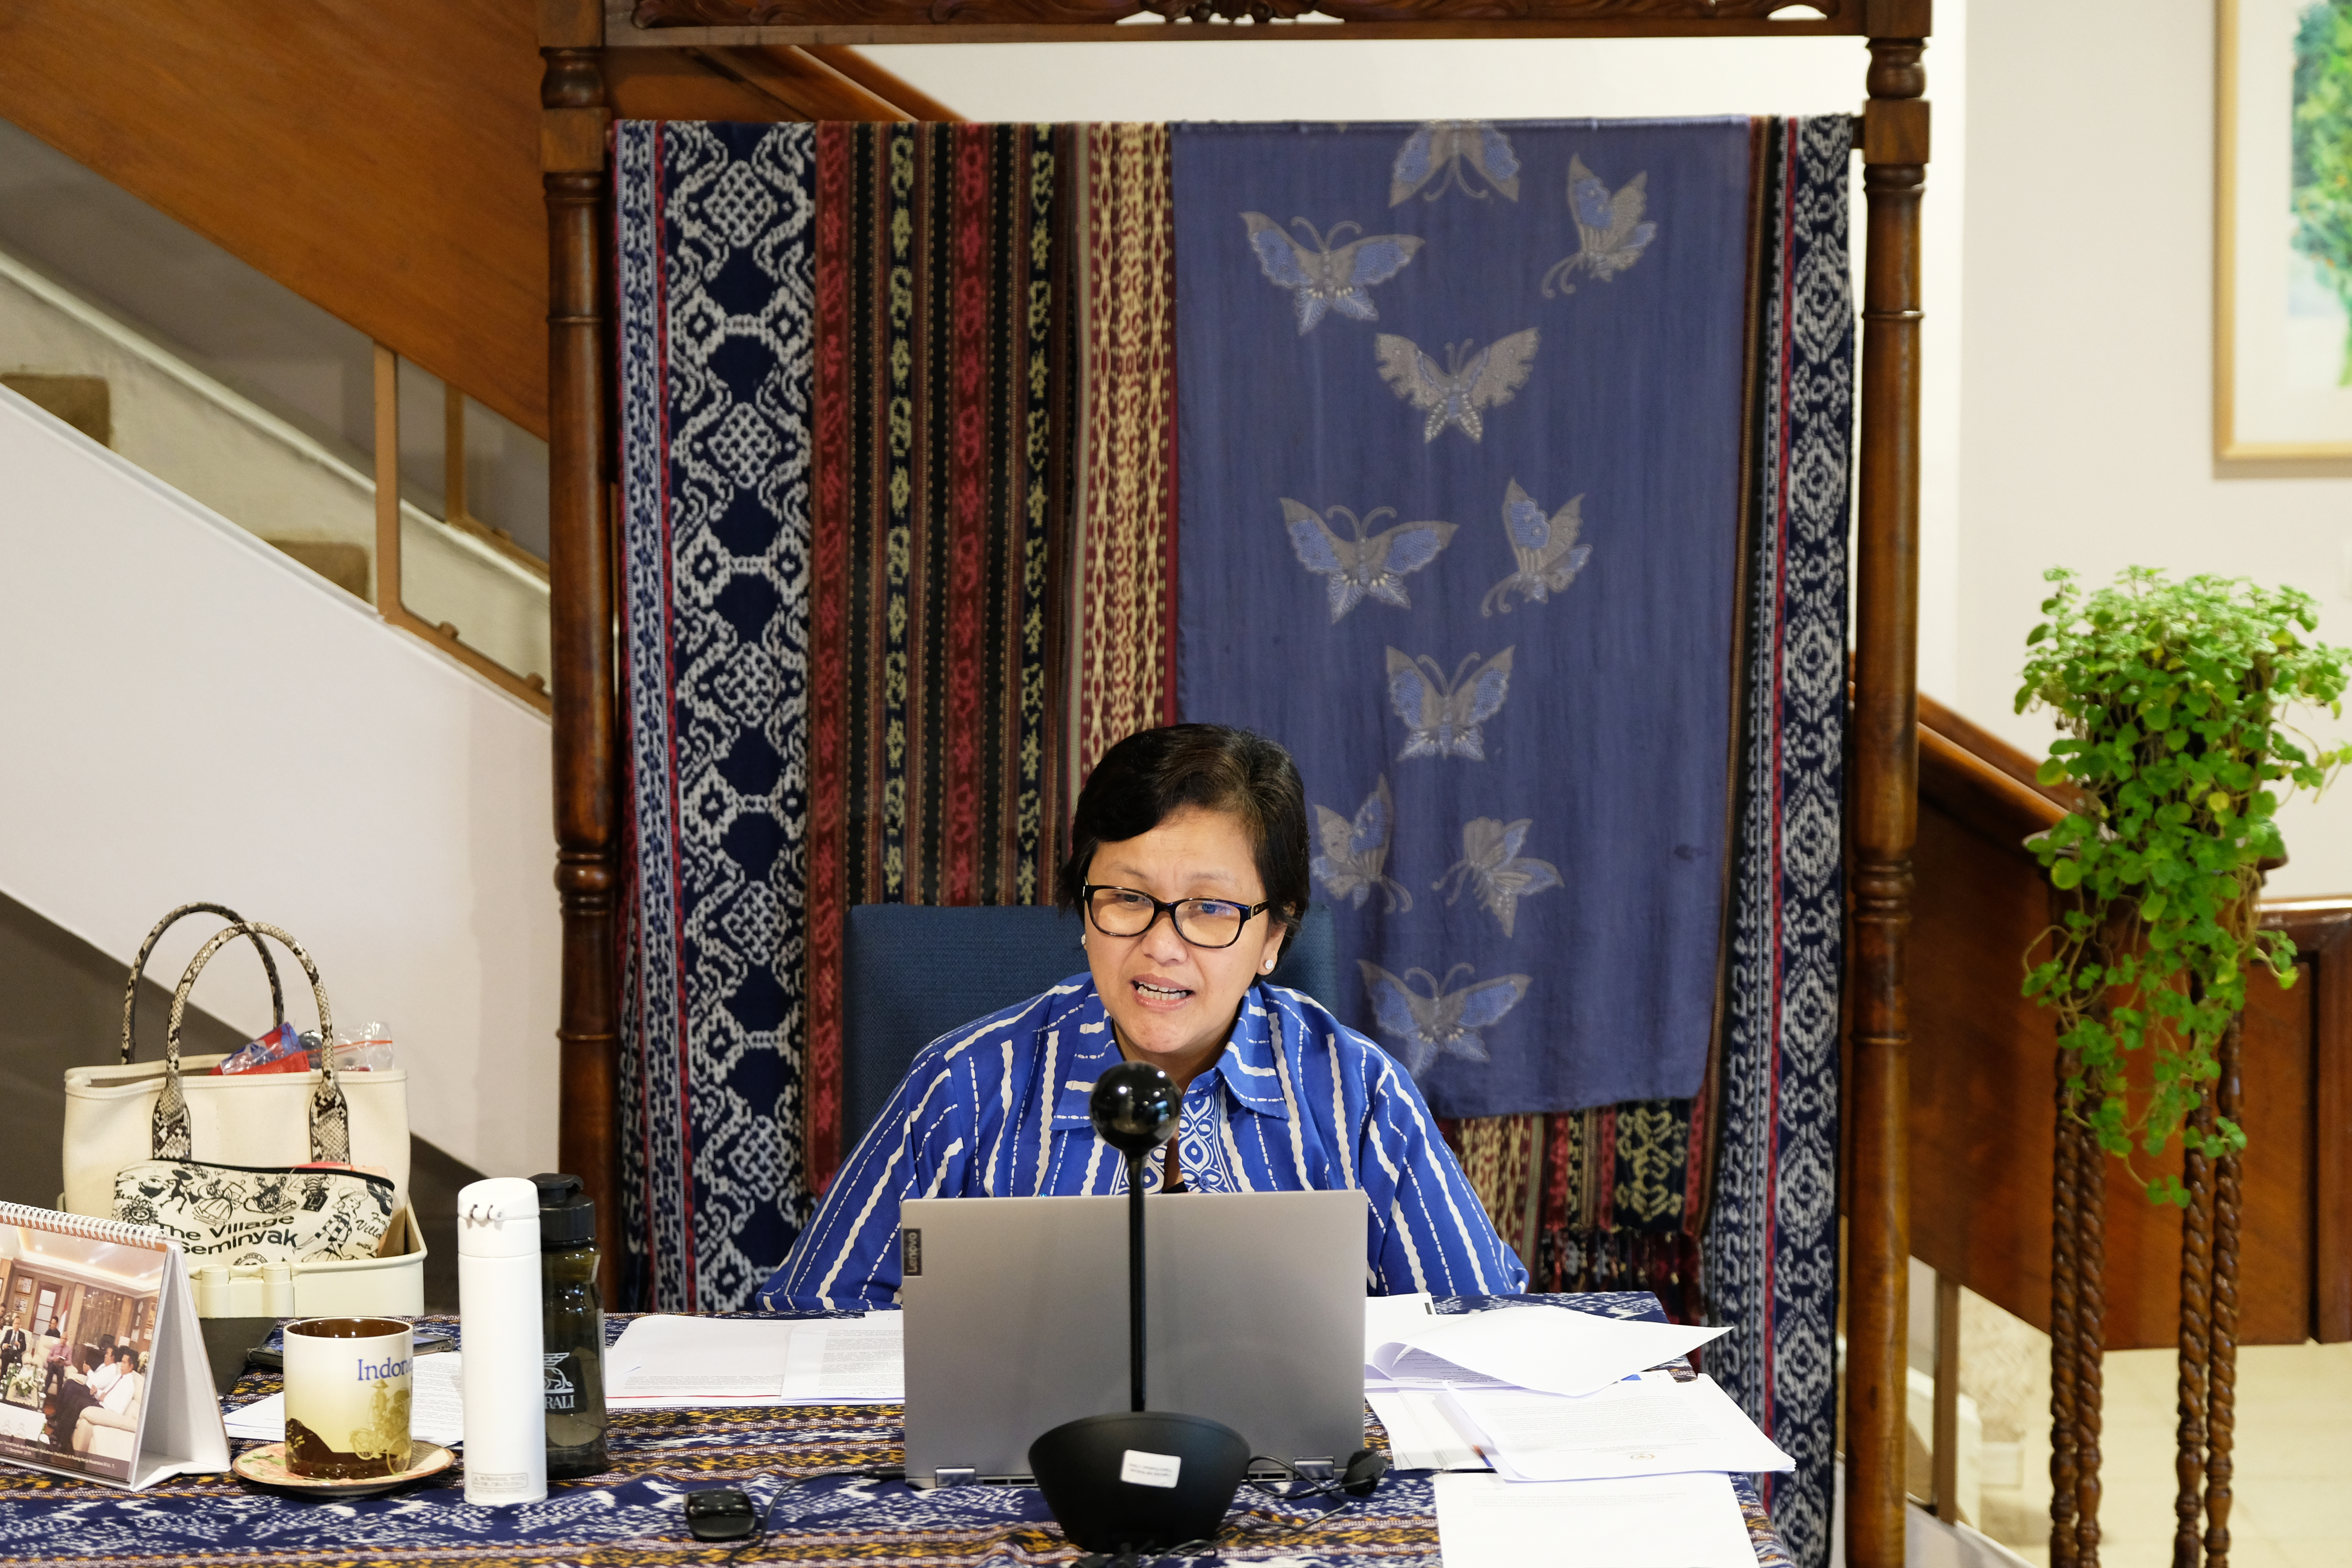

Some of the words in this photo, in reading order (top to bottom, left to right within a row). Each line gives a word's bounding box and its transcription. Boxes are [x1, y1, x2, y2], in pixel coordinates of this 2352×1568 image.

[154, 1222, 201, 1240] The
[209, 1216, 294, 1238] Village
[182, 1228, 298, 1254] Seminyak
[907, 1232, 918, 1273] Lenovo
